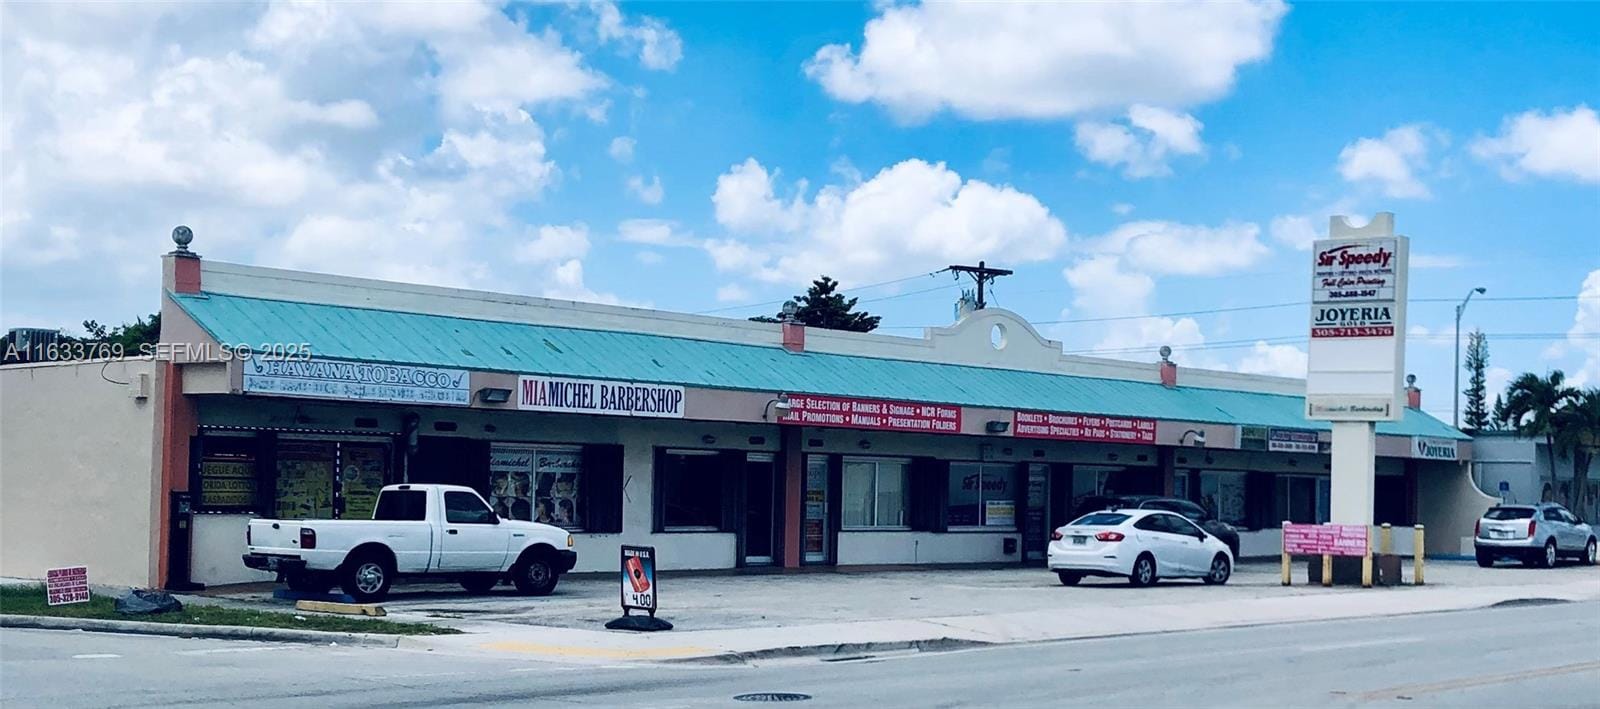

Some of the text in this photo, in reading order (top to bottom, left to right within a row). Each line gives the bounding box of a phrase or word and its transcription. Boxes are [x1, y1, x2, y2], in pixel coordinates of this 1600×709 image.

[1317, 247, 1392, 270] Sir Speedy
[1321, 276, 1386, 289] Full Color Printing
[1314, 307, 1392, 322] JOYERIA
[1314, 327, 1392, 336] 305-713-3476
[266, 360, 451, 388] HAVANA TOBACCO
[522, 379, 683, 414] MIAMICHEL BARBERSHOP
[787, 398, 957, 419] ARGE SELECTION OF BANNERS & SIGNAGE NCR FORMS
[801, 411, 844, 424] PROMOTIONS
[851, 414, 881, 426] MANUALS
[888, 416, 930, 429] PRESENTATION
[931, 419, 957, 431] FOLDERS
